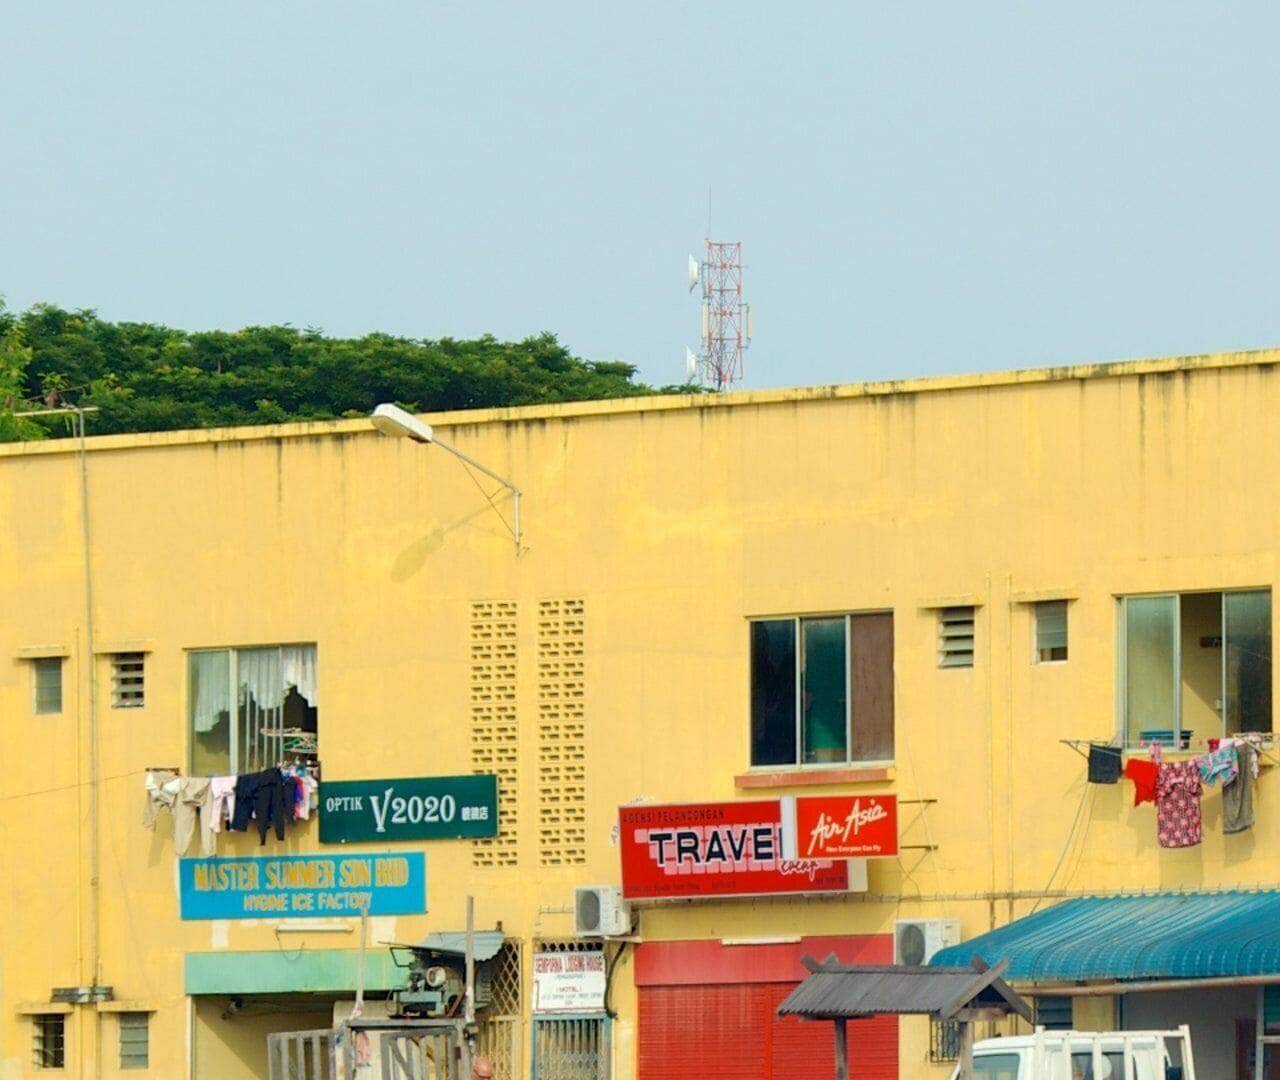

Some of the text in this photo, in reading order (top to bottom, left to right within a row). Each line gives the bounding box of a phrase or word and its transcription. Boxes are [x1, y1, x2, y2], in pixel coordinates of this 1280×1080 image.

[326, 796, 363, 812] OPTIK
[369, 787, 456, 833] V2020
[807, 798, 887, 855] Air Asia
[194, 863, 259, 892] MASTER
[266, 860, 336, 890] SUMMER
[293, 893, 314, 911] ICE
